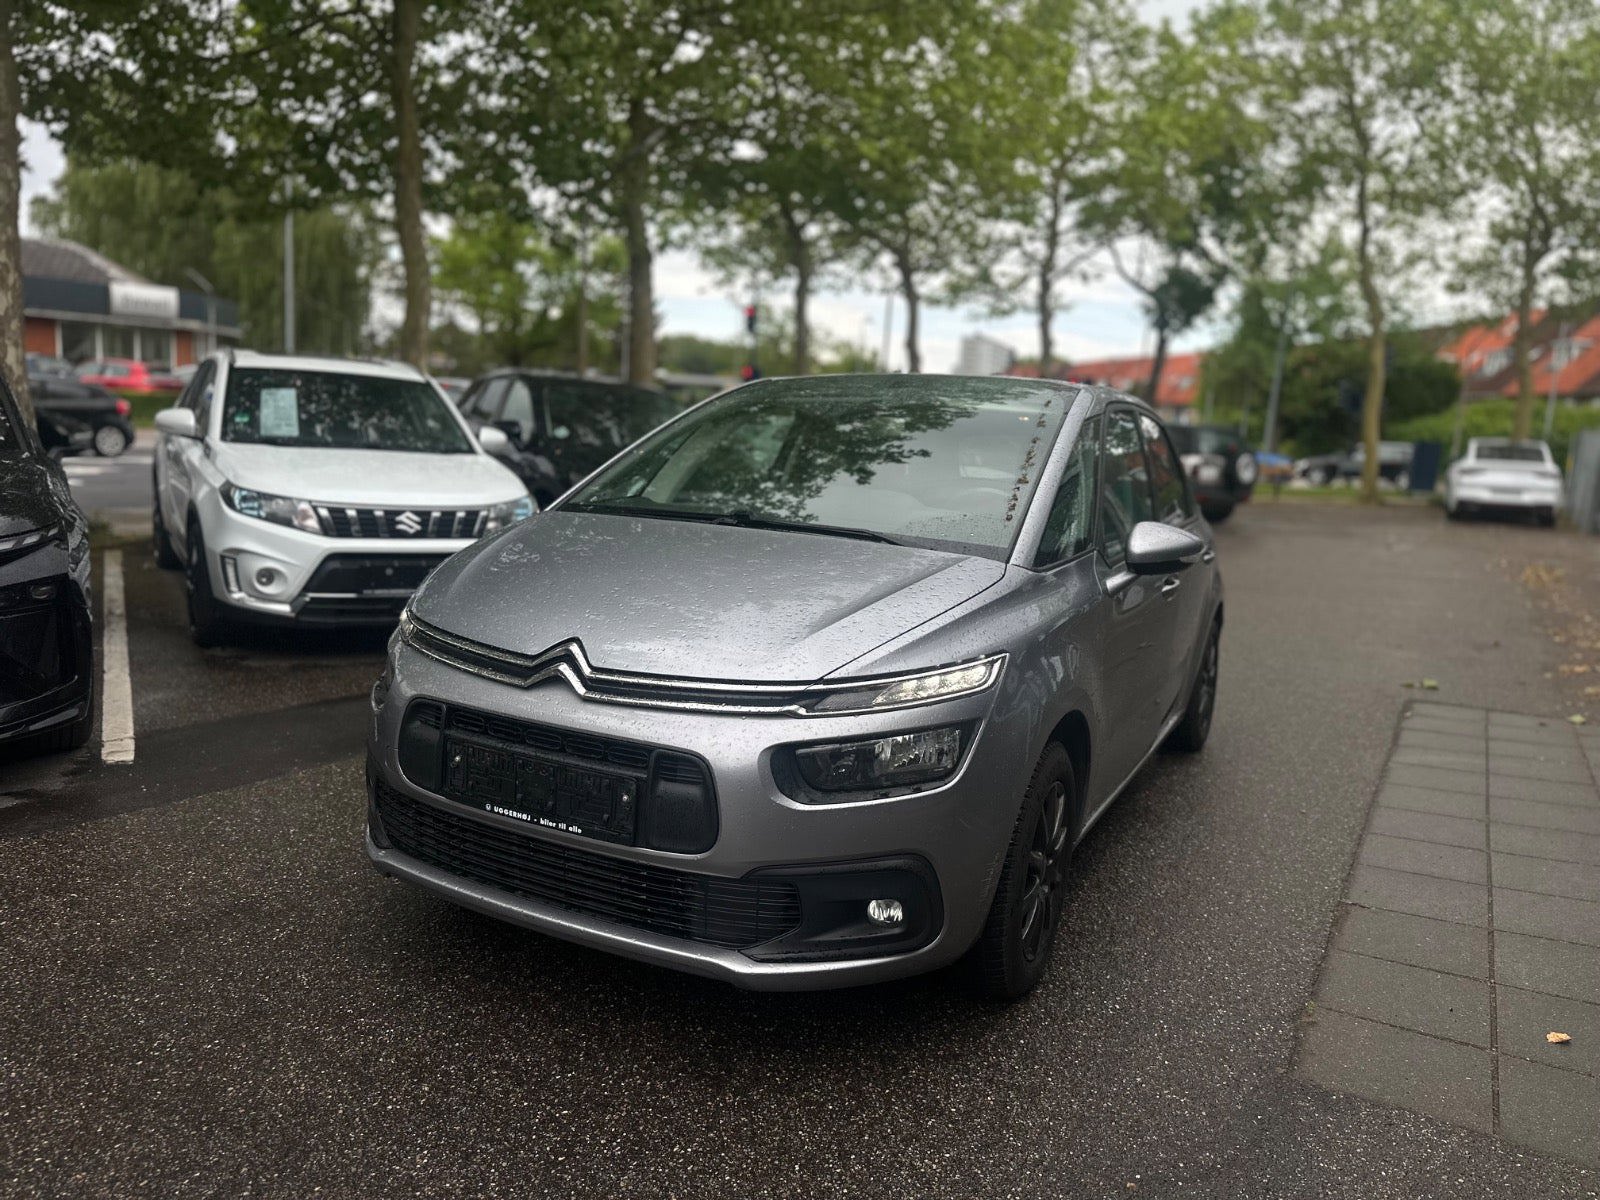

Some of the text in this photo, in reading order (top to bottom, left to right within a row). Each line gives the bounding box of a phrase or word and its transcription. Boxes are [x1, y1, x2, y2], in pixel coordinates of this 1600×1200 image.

[493, 806, 531, 821] UGGERHØJ
[540, 818, 557, 827] biler
[568, 826, 582, 834] alle
